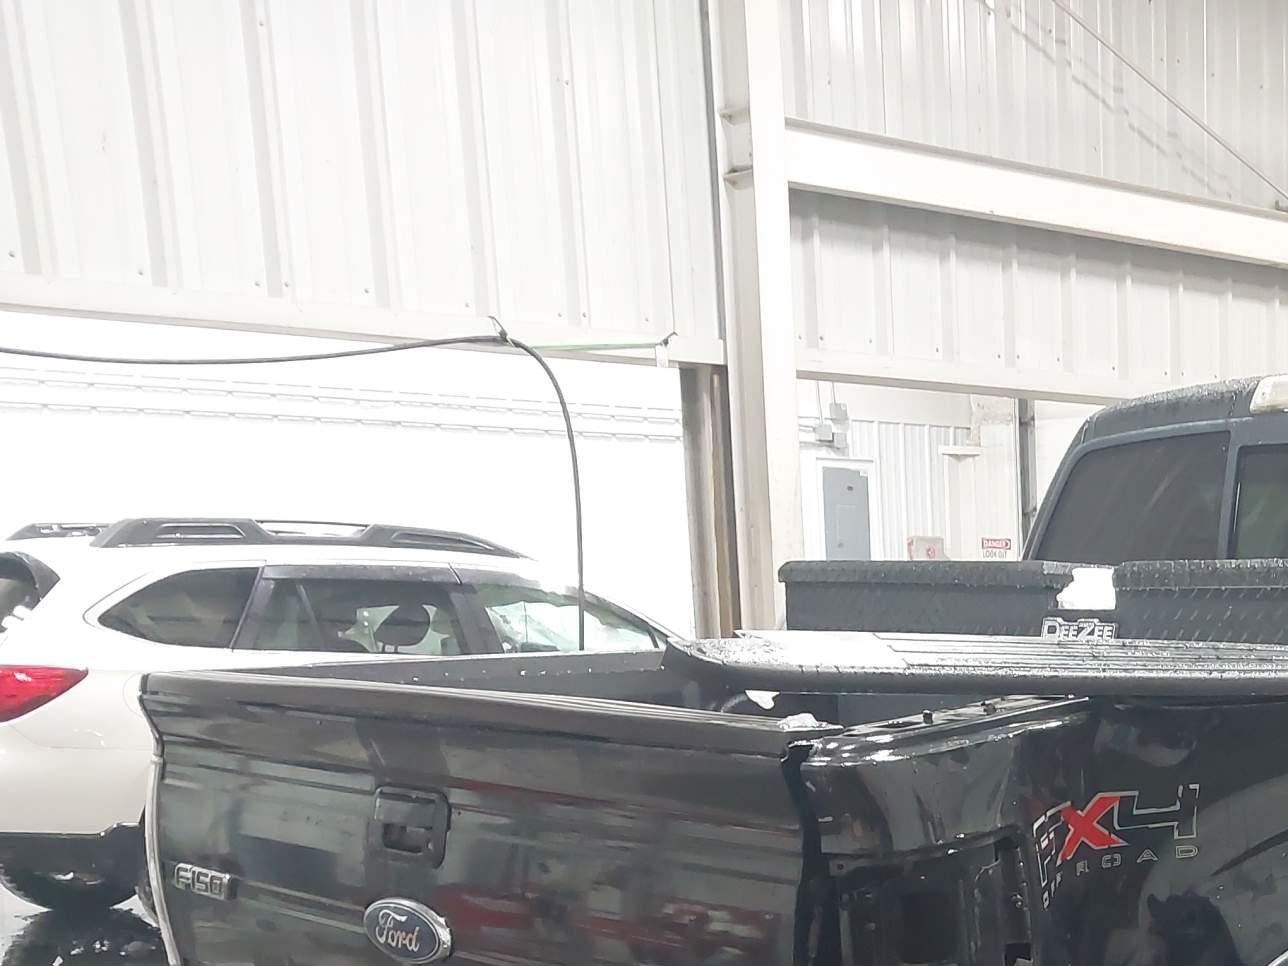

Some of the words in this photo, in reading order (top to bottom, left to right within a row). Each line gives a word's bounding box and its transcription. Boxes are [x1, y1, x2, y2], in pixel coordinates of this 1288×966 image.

[983, 551, 998, 559] LOOK
[1032, 783, 1200, 888] FX4
[1075, 845, 1199, 877] ROAD
[374, 908, 421, 953] Ford
